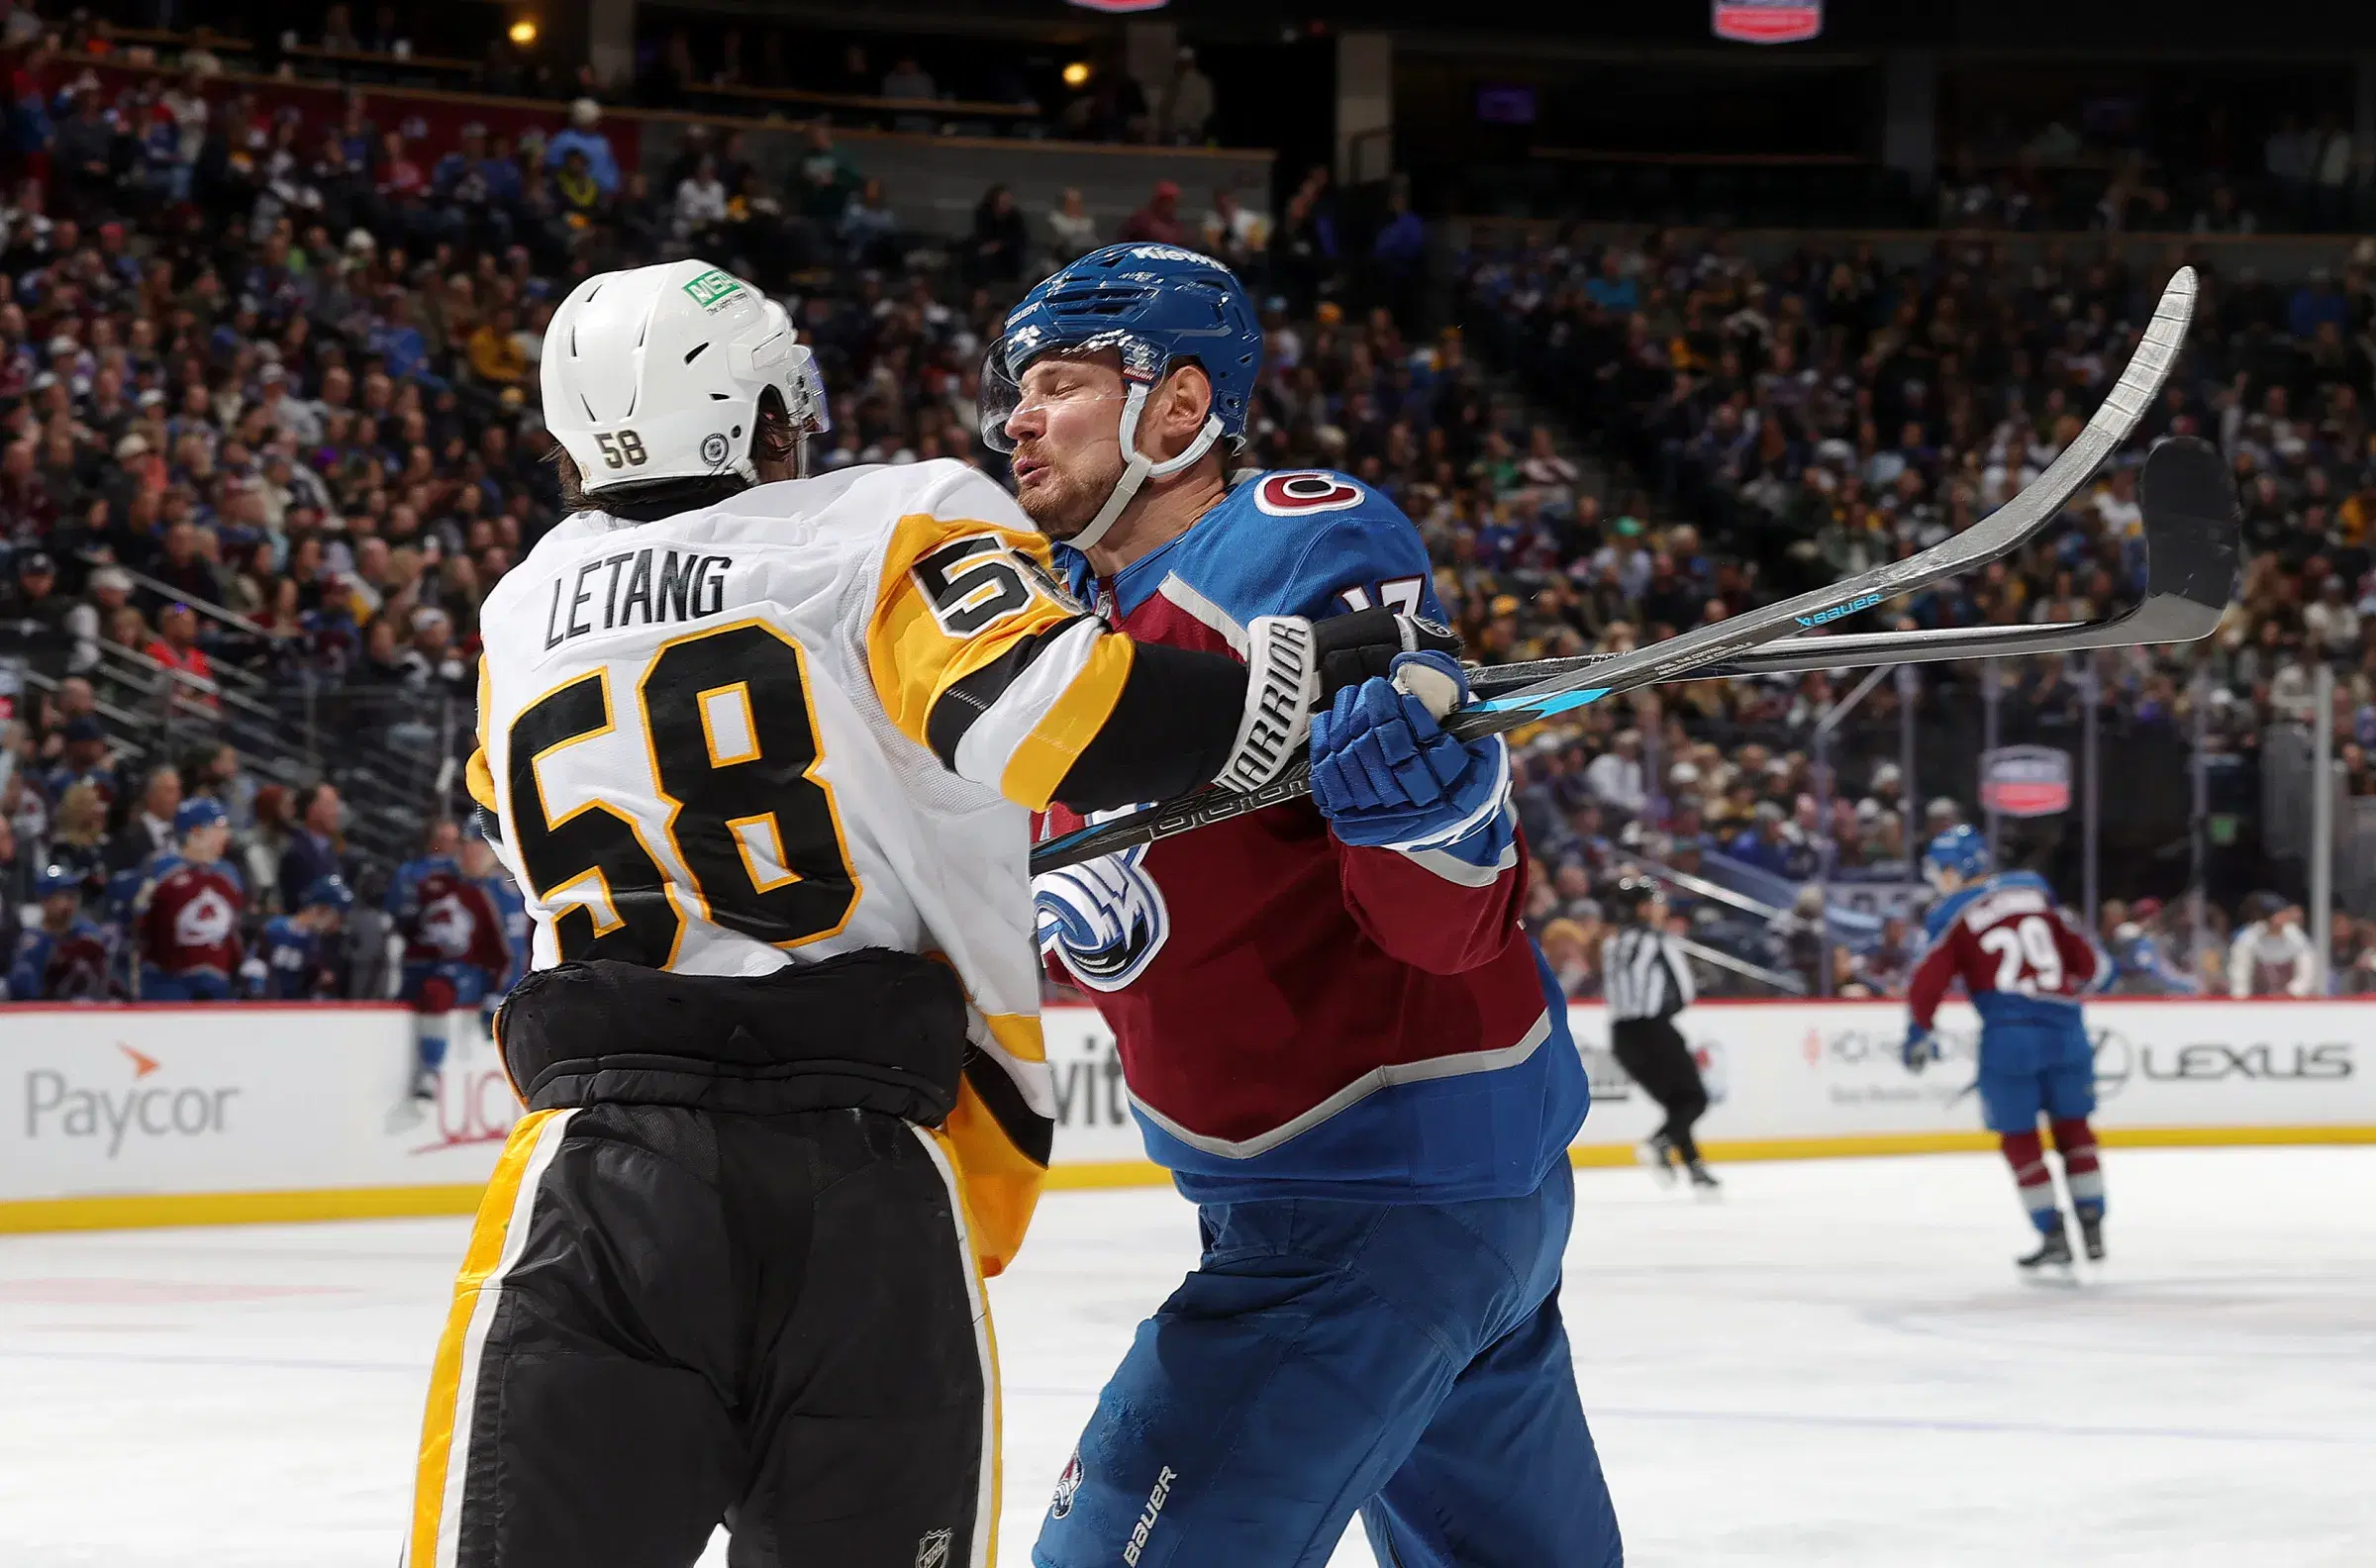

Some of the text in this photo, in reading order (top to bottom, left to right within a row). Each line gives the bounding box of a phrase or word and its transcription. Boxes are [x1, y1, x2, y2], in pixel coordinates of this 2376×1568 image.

[592, 429, 648, 469] 58
[544, 547, 734, 651] LETANG
[908, 533, 1085, 640] 5
[507, 616, 864, 973] 58
[1979, 915, 2062, 996] 29
[2139, 1041, 2355, 1082] LEXUS
[24, 1069, 242, 1160] Paycor
[1123, 1465, 1178, 1568] BAUER
